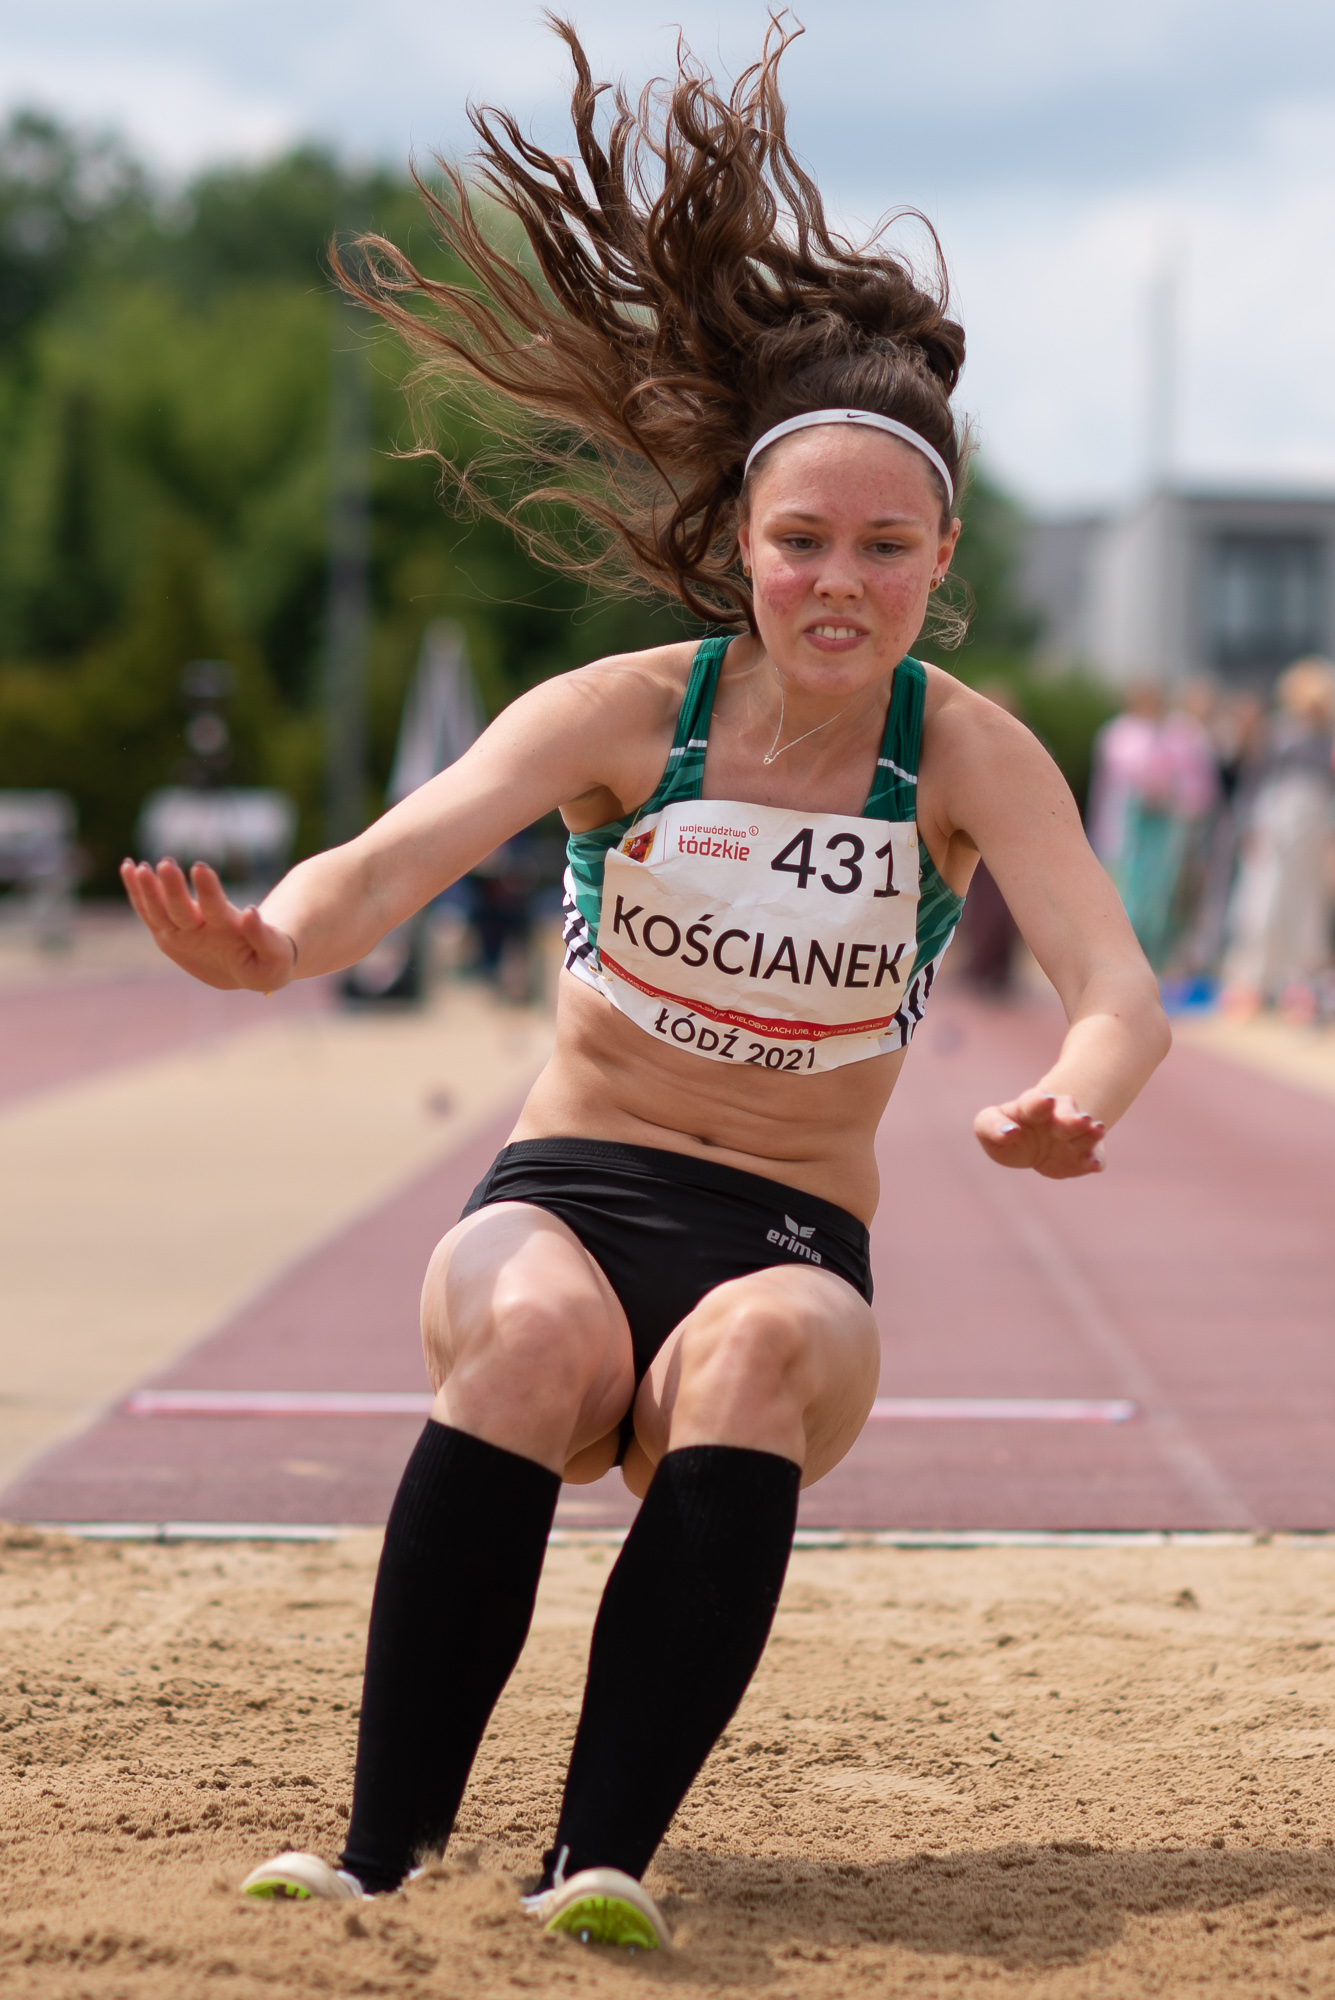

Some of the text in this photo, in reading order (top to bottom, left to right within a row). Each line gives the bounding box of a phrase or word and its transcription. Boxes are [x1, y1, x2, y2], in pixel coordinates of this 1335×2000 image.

[678, 835, 750, 862] łódzkie
[679, 824, 747, 838] województwo
[770, 827, 900, 898] 431
[612, 894, 907, 988] KOŚCIANEK
[654, 1007, 816, 1071] ŁÓDŹ 2021
[728, 1013, 791, 1035] WIELOBOJACH
[766, 1229, 822, 1264] erima
